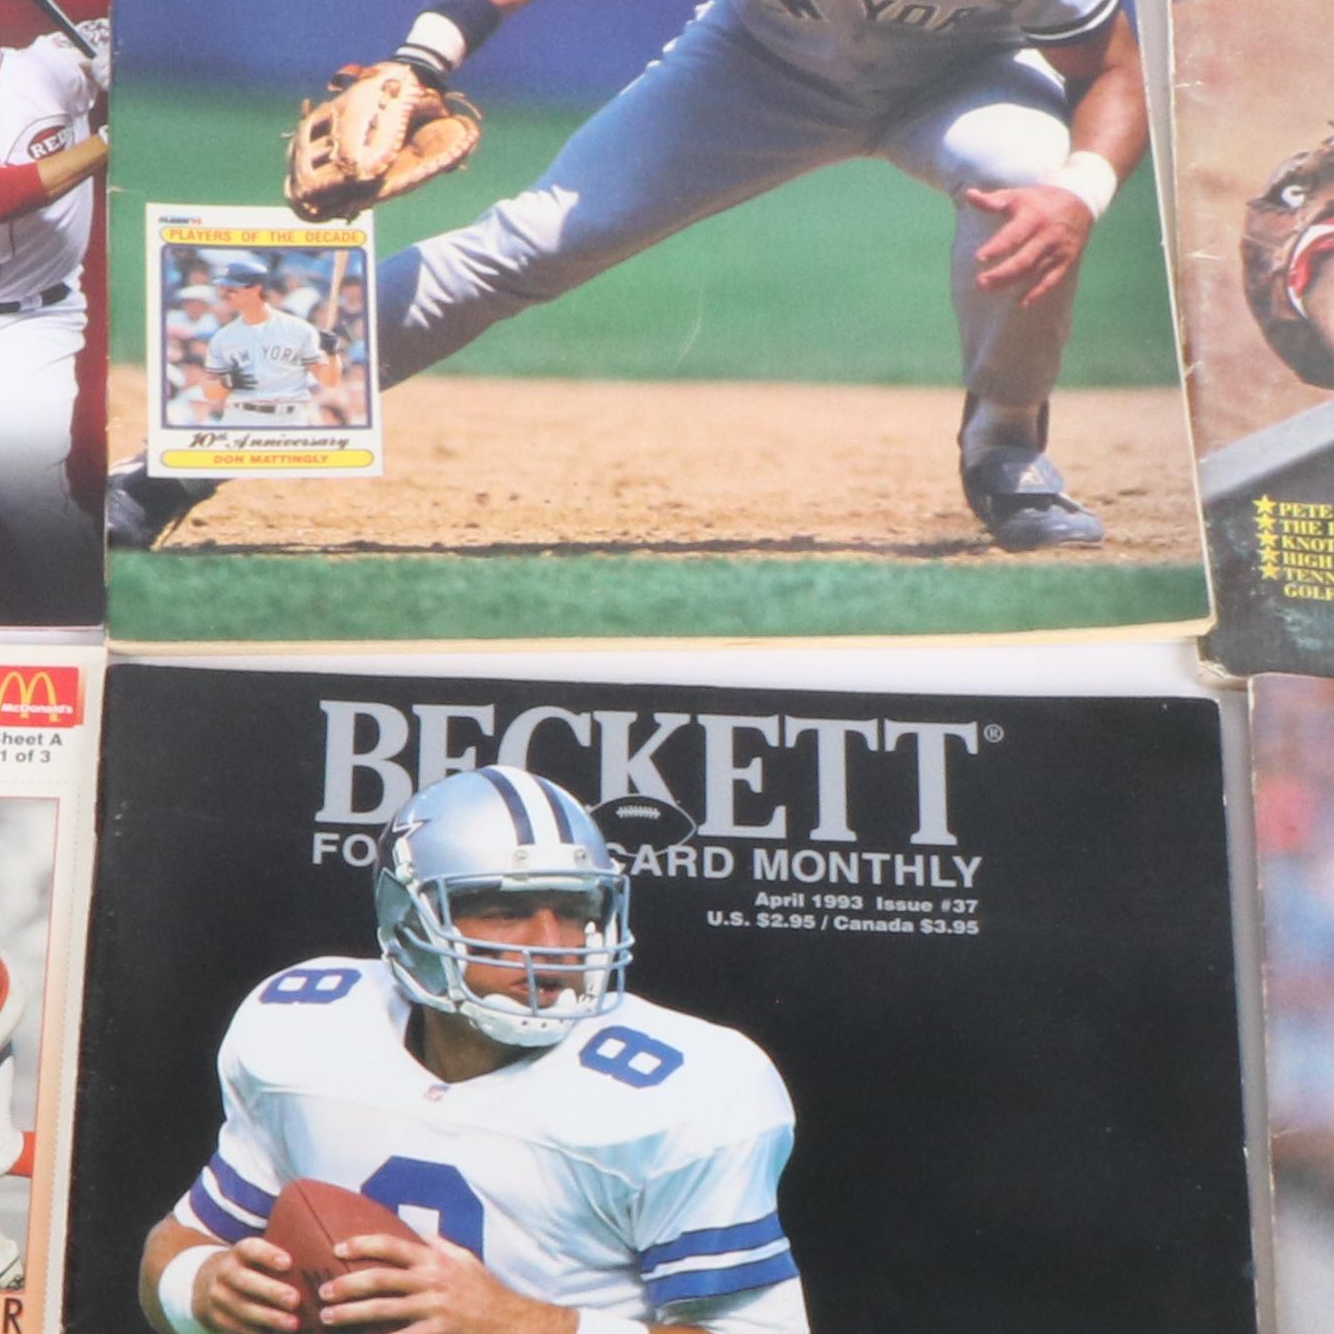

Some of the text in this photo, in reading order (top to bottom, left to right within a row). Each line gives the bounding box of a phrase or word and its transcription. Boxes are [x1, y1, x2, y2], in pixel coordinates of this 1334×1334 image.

[169, 228, 360, 244] PLAYERS OF THE DECADE
[213, 454, 329, 465] DON MATTINGLY
[1279, 501, 1334, 519] PETE
[1280, 519, 1323, 536] THE
[1281, 552, 1333, 570] HIGH
[48, 732, 63, 747] A
[0, 748, 52, 764] 1 of 3
[753, 847, 983, 889] MONTHLY
[754, 890, 979, 914] April 1993 Issue #37
[707, 910, 980, 936] U.S. $2.95 Canada $3.95
